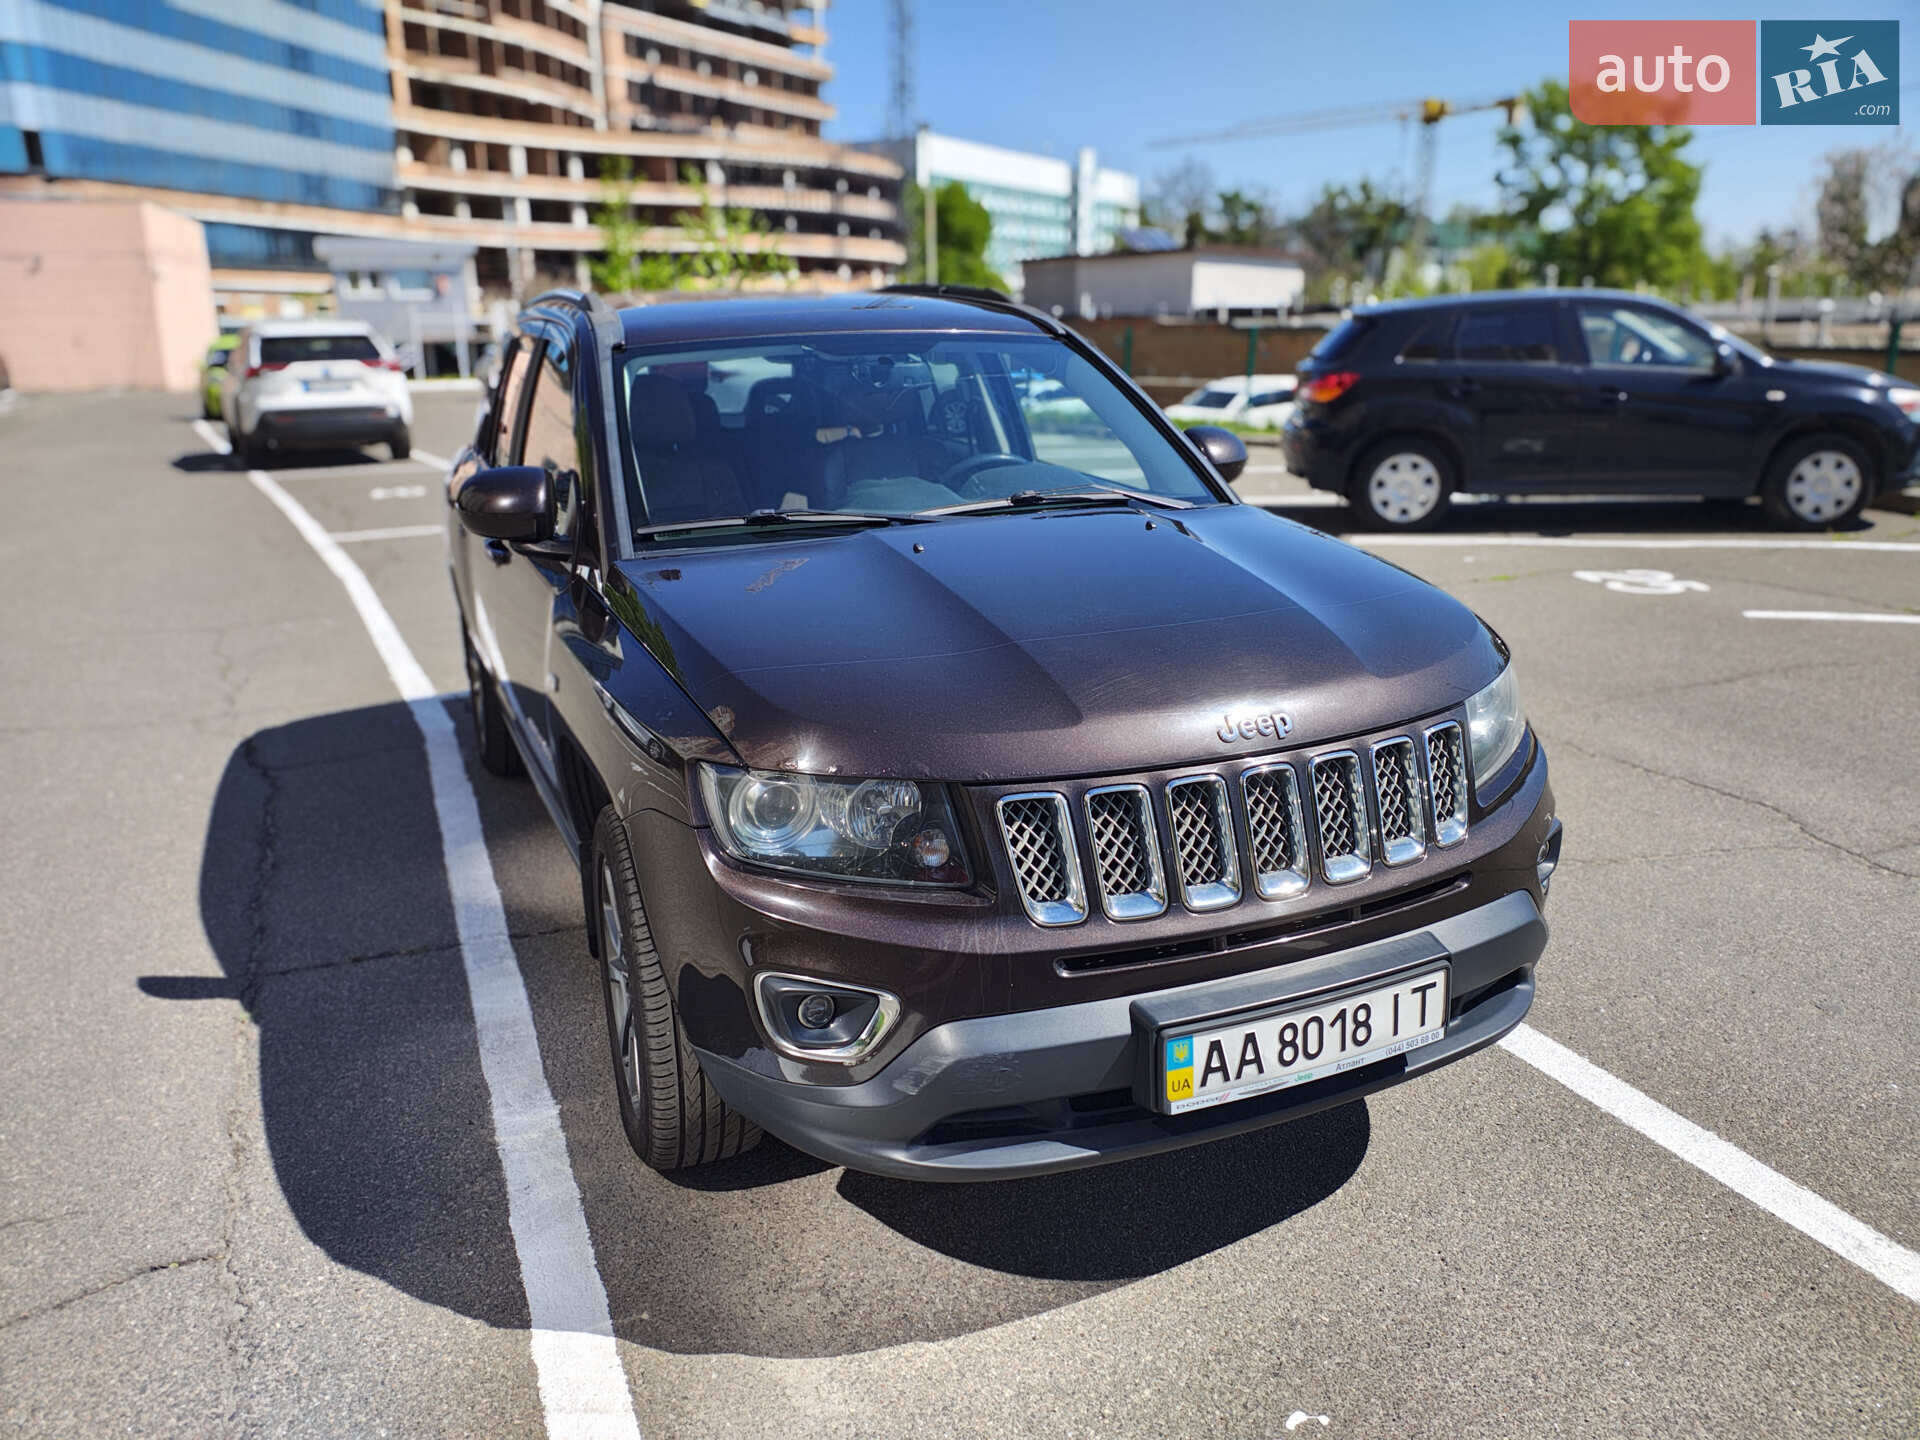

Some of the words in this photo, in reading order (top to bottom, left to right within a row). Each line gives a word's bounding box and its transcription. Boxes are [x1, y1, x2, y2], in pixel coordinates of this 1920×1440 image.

[1217, 710, 1293, 743] Jeep
[1199, 1032, 1265, 1087] AA
[1277, 1003, 1371, 1067] 8018
[1335, 1058, 1365, 1071] Атлант
[1171, 1077, 1191, 1093] UA
